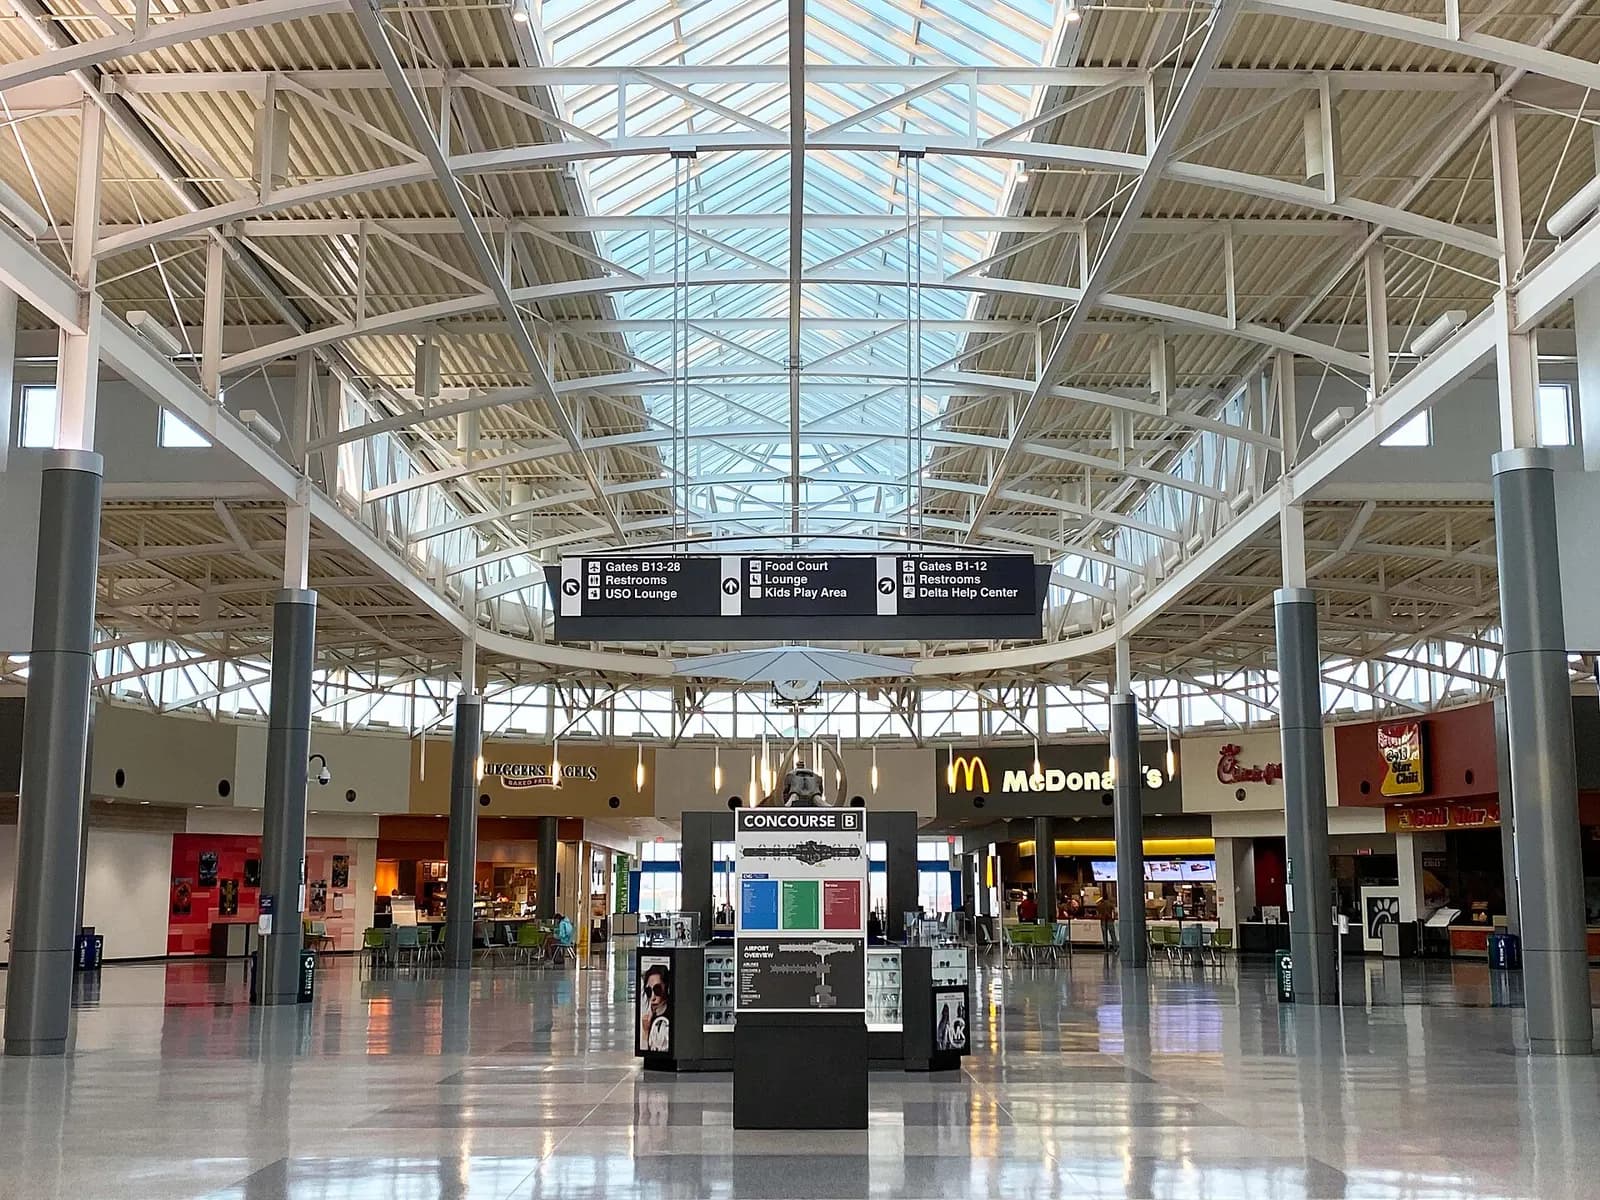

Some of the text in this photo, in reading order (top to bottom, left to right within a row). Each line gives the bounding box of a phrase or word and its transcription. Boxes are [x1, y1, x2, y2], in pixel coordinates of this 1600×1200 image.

[605, 561, 681, 572] Gates B13-28
[765, 560, 829, 571] Food Court
[919, 560, 988, 571] Gates B1-12
[605, 575, 668, 585] Restrooms
[765, 574, 808, 586] Lounge
[919, 574, 982, 585] Restrooms
[605, 588, 678, 601] USO Lounge
[765, 587, 847, 600] Kids Play Area
[919, 587, 1019, 600] Delta Help Center
[550, 764, 598, 781] AGELS
[1392, 761, 1412, 773] Star
[1002, 765, 1163, 792] McDona's
[1396, 771, 1419, 785] Chili
[744, 815, 855, 828] CONCOURSE B
